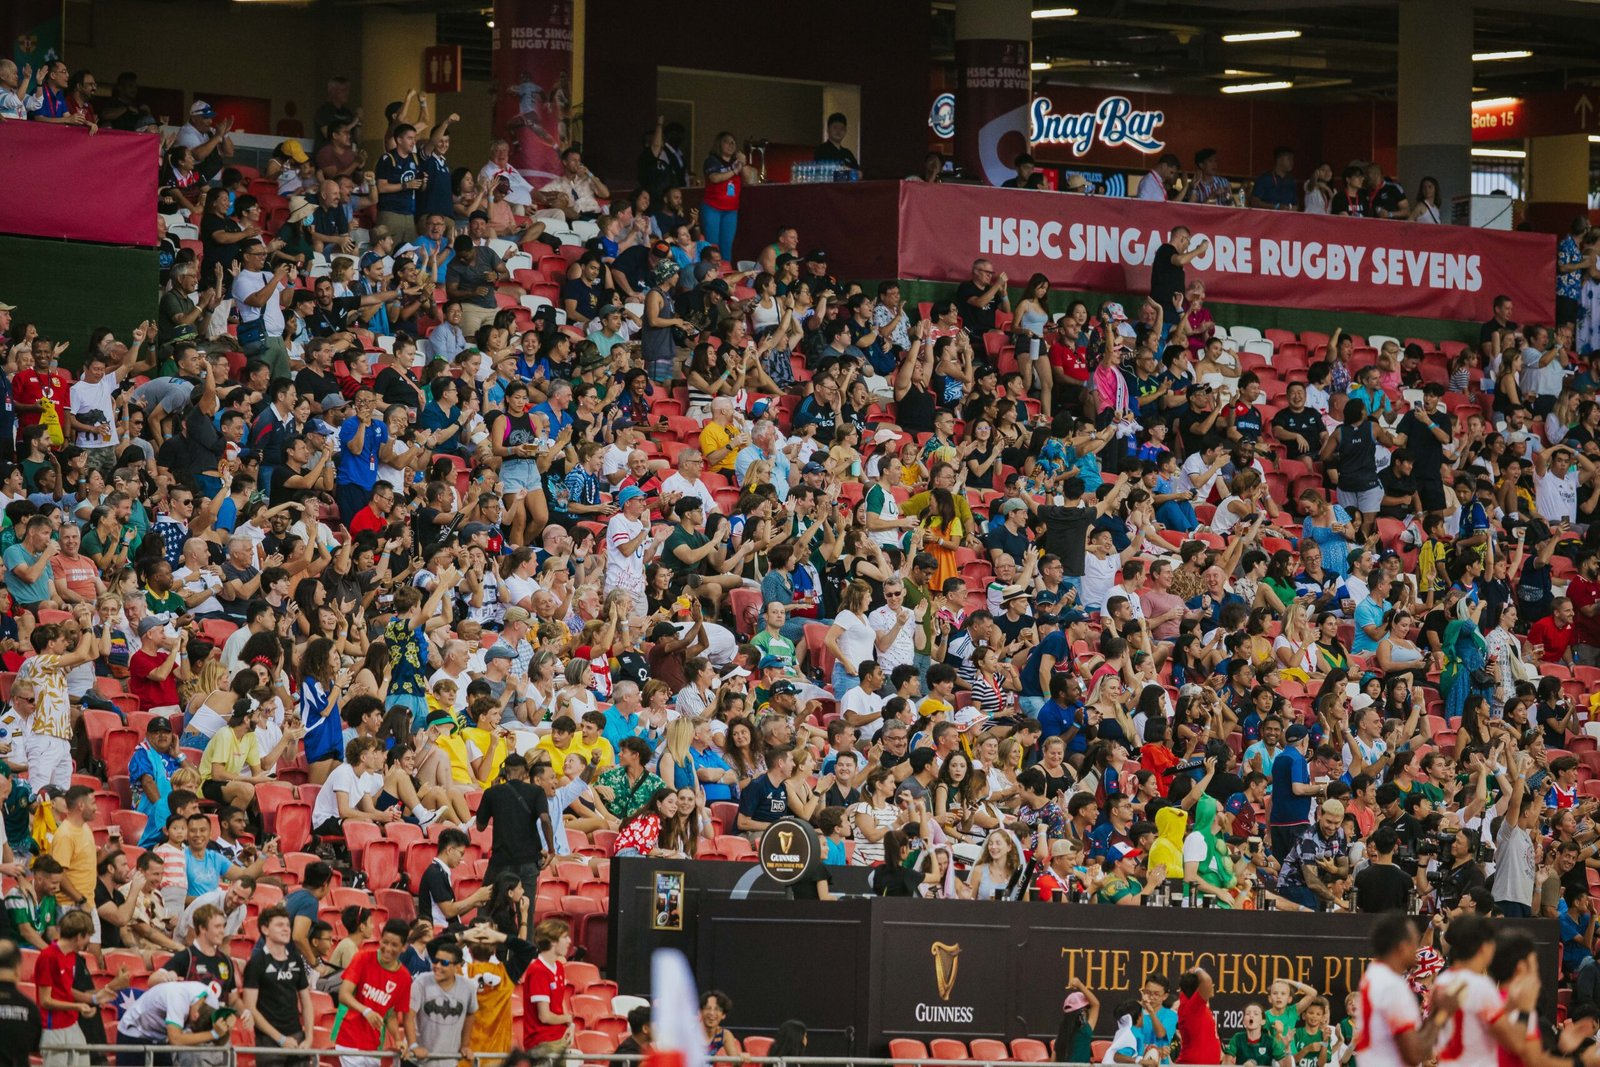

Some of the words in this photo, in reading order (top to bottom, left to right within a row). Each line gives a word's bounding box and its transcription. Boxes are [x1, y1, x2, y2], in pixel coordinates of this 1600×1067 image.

[511, 28, 543, 38] HSBC
[511, 39, 547, 49] RUGBY
[967, 67, 995, 77] HSBC
[967, 78, 1001, 88] RUGBY
[1030, 96, 1096, 156] Snag
[1096, 95, 1165, 154] Bar
[1472, 112, 1498, 128] Gate
[1500, 112, 1515, 127] 15
[980, 215, 1063, 259] HSBC
[1069, 223, 1252, 274] SINGAORE
[1260, 238, 1367, 282] RUGBY
[1371, 247, 1482, 291] SEVENS
[770, 853, 800, 862] GUINNESS
[277, 970, 294, 981] AIG
[1061, 947, 1131, 993] THE
[1323, 956, 1372, 997] PU
[361, 983, 392, 1007] CYMRU
[915, 1003, 974, 1026] GUINNESS
[1223, 1010, 1244, 1029] 202
